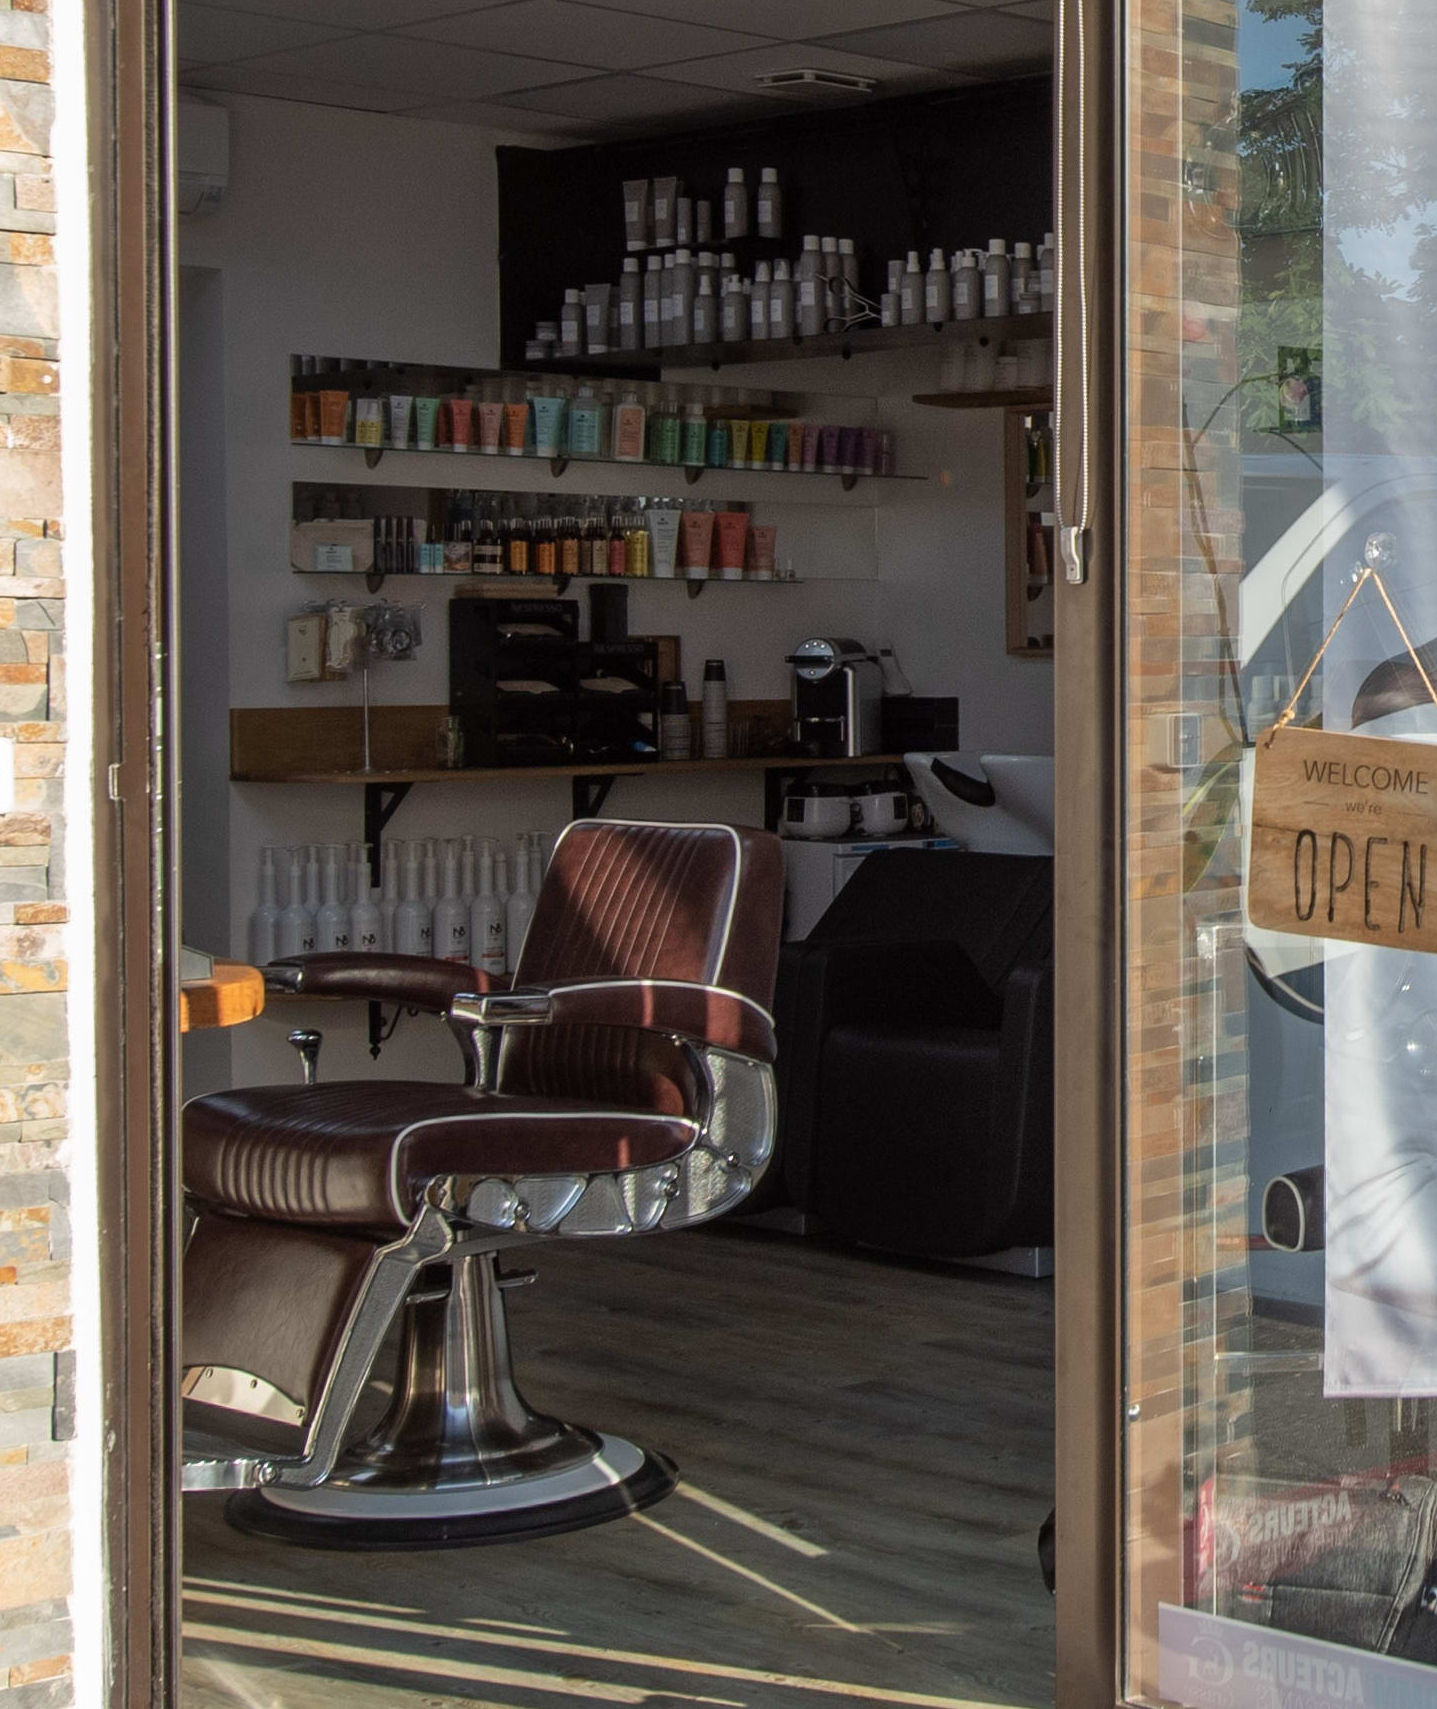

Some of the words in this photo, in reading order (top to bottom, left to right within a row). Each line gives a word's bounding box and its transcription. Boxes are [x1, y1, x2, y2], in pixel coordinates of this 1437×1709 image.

[1302, 758, 1430, 796] WELCOME
[1344, 799, 1382, 816] we're
[1293, 827, 1428, 934] OPEN
